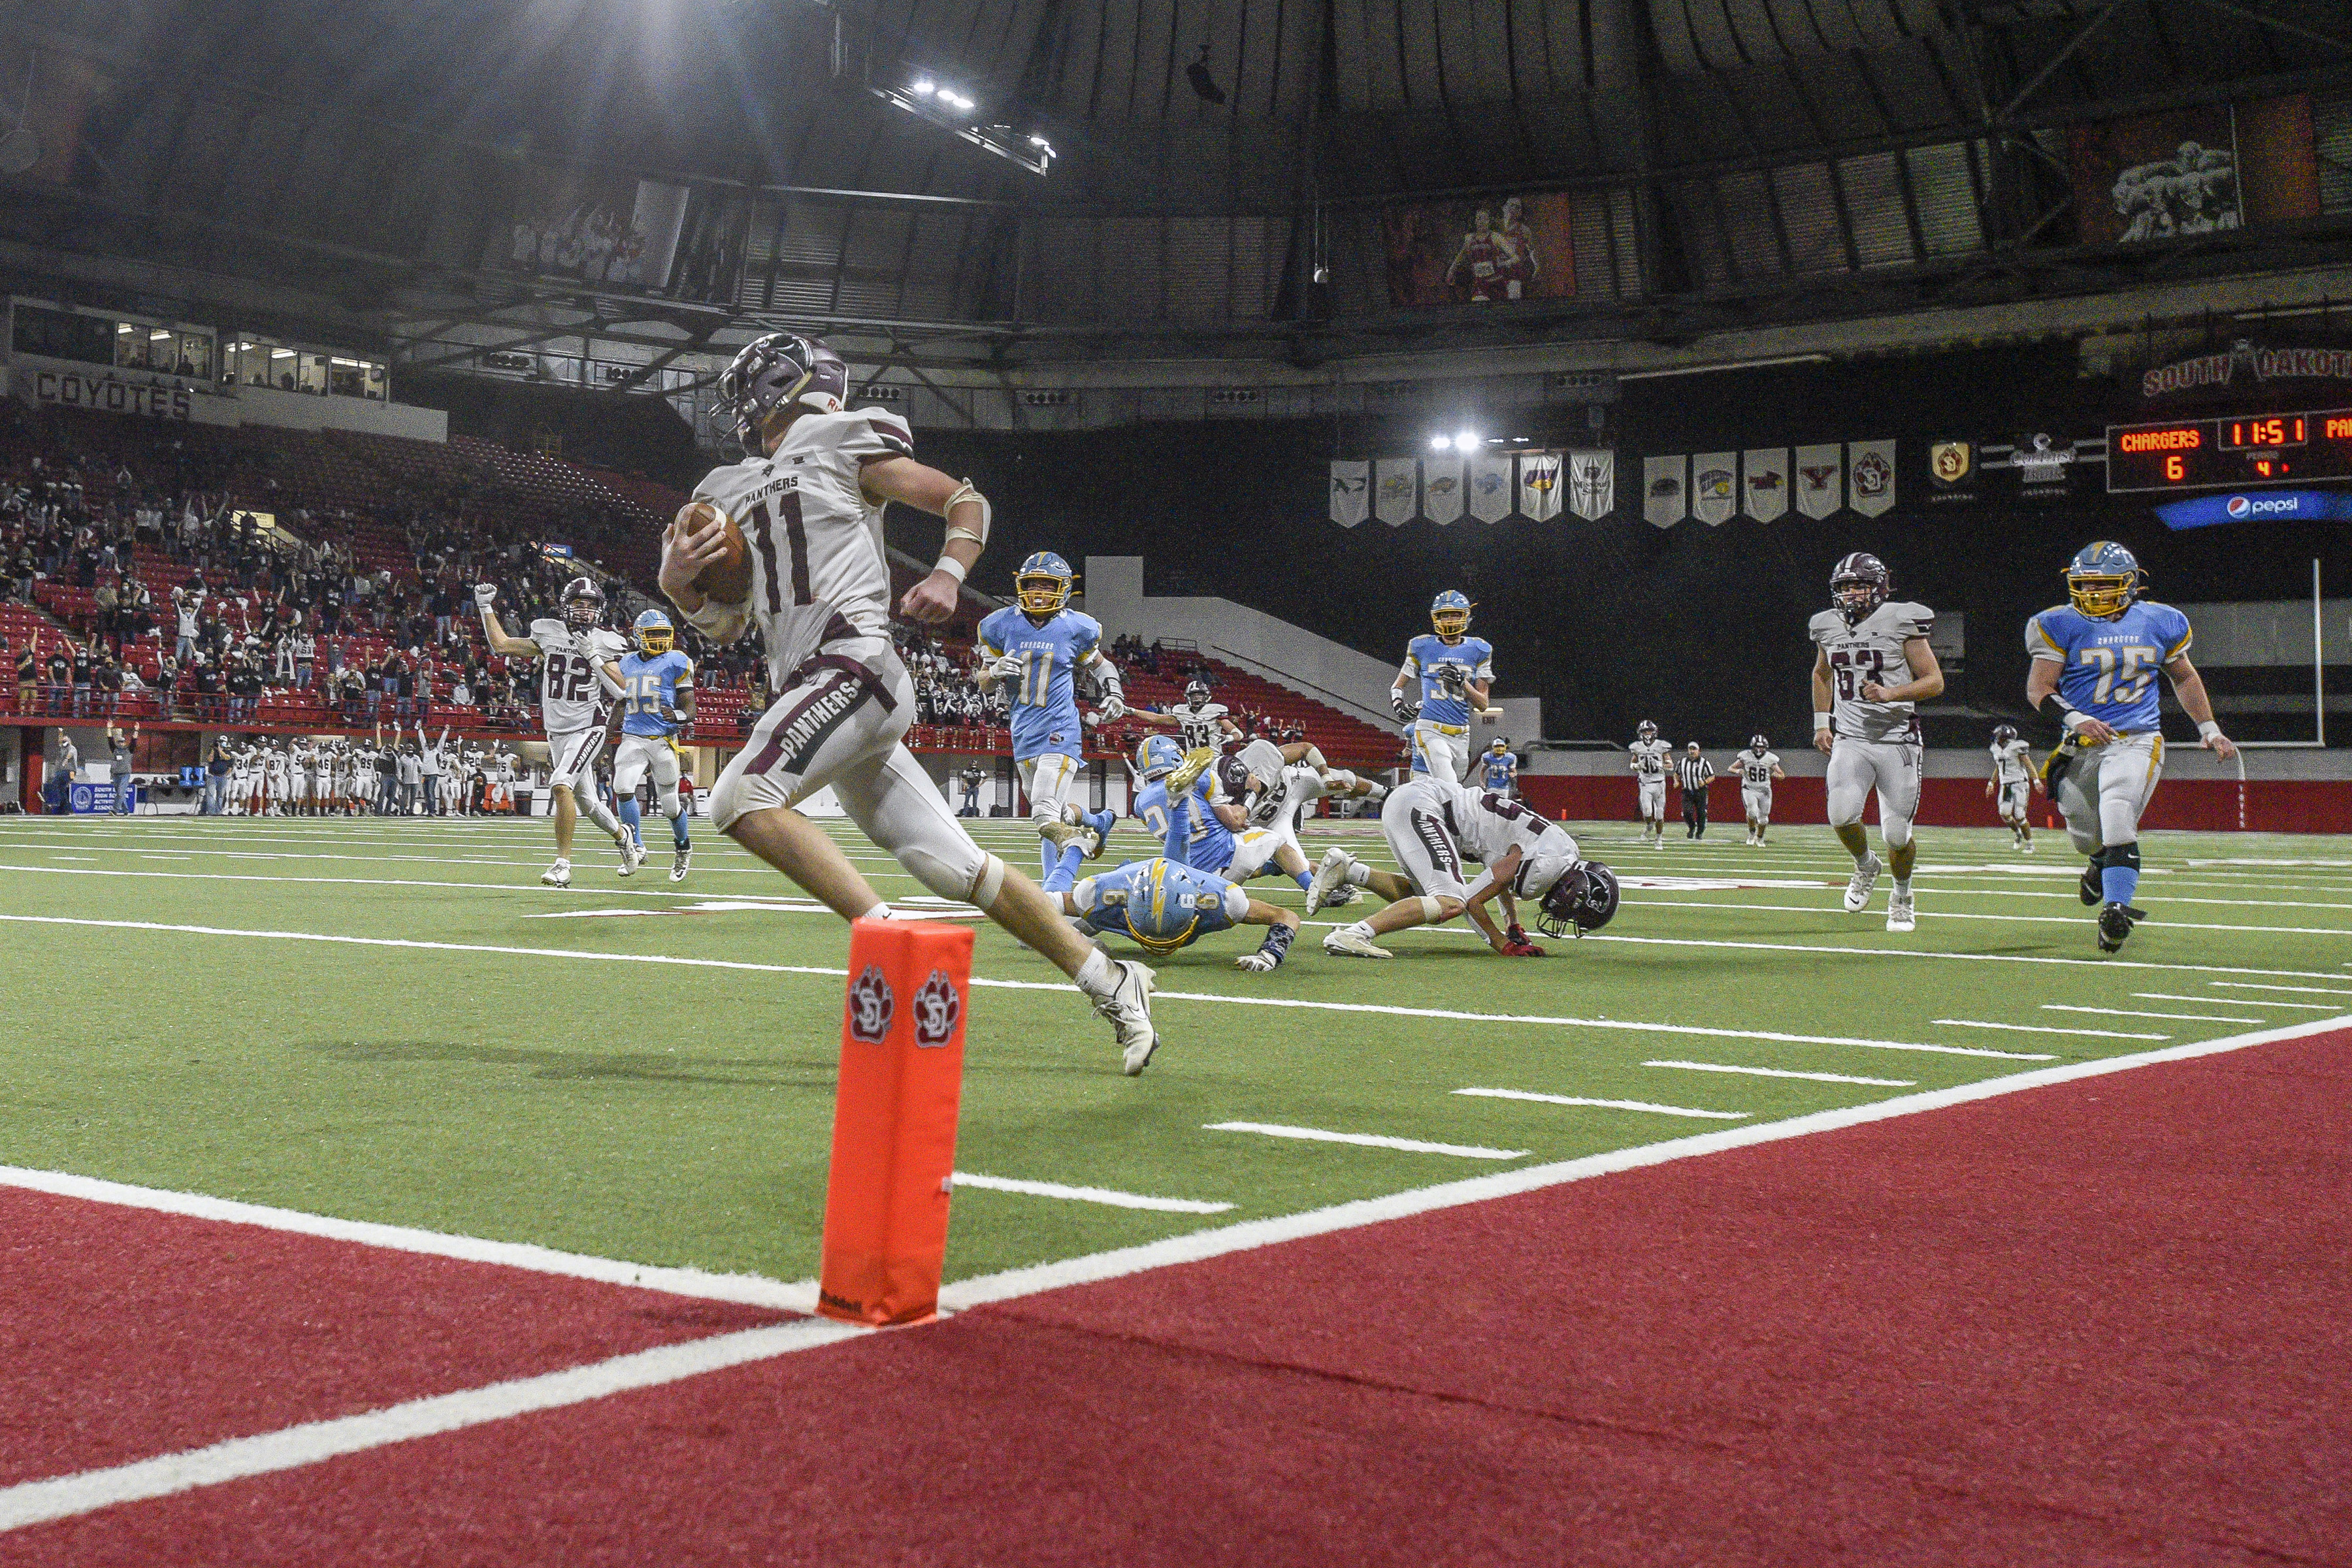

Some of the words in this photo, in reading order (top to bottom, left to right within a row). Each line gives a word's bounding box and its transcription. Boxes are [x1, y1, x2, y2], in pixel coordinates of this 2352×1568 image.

[2143, 350, 2233, 397] SOUTH
[37, 372, 190, 420] COYOTES
[2121, 430, 2200, 453] CHARGERS
[2233, 419, 2304, 446] 11:51
[2166, 455, 2184, 480] 6
[2257, 461, 2271, 476] 4
[745, 476, 798, 505] PANTHERS
[2252, 497, 2298, 514] pepsi
[751, 491, 812, 615] 11
[1019, 641, 1054, 650] CHARGERS
[1837, 642, 1870, 650] PANTHERS
[547, 654, 592, 701] 82
[1019, 650, 1054, 708] 11
[1831, 649, 1884, 701] 63
[2080, 646, 2156, 704] 75
[779, 681, 858, 759] PANTHERS
[1185, 725, 1209, 747] 83
[237, 759, 248, 770] 34
[318, 759, 329, 770] 46
[577, 735, 598, 767] PANTHERS
[269, 759, 281, 771] 87
